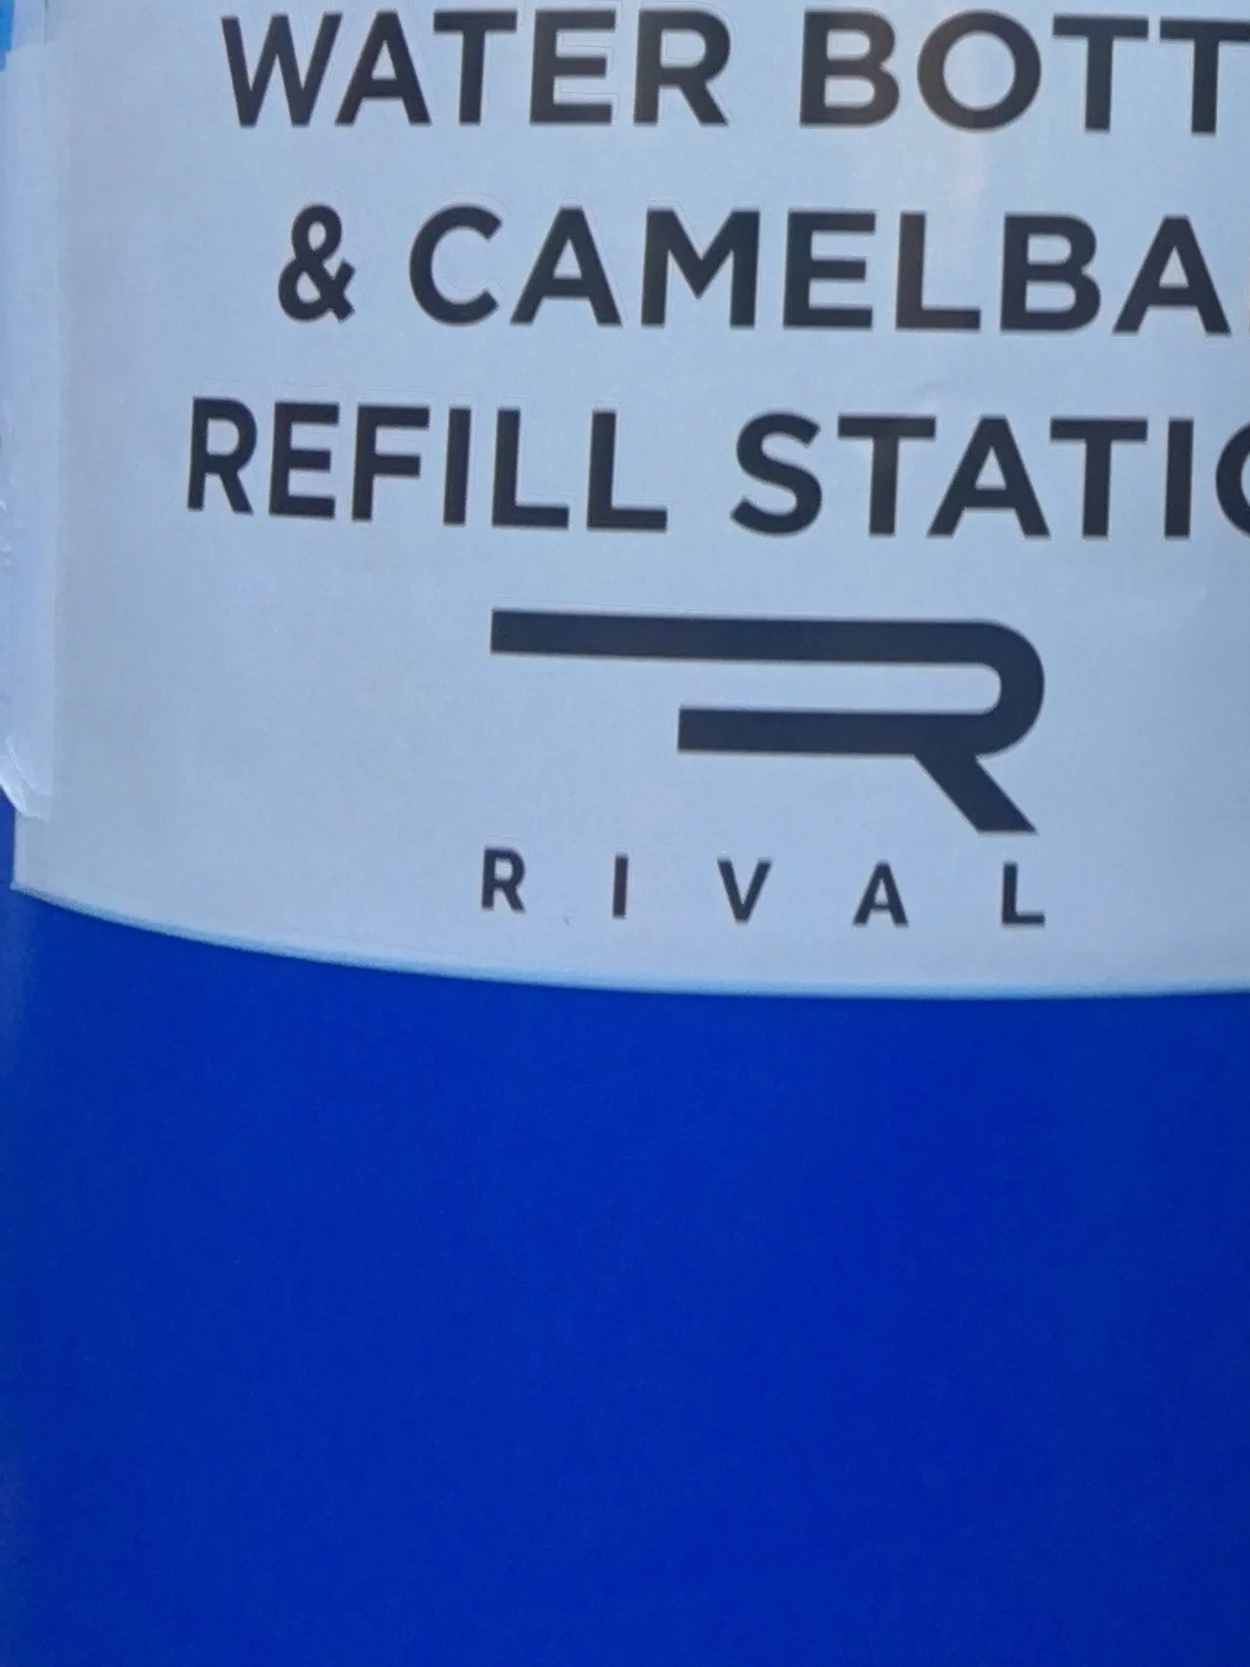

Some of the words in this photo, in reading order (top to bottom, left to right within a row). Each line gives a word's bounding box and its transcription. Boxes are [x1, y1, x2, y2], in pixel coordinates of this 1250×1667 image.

[222, 10, 730, 128] WATER
[279, 205, 355, 321] &
[188, 398, 667, 532] REFILL
[482, 848, 1045, 926] RIVAL
